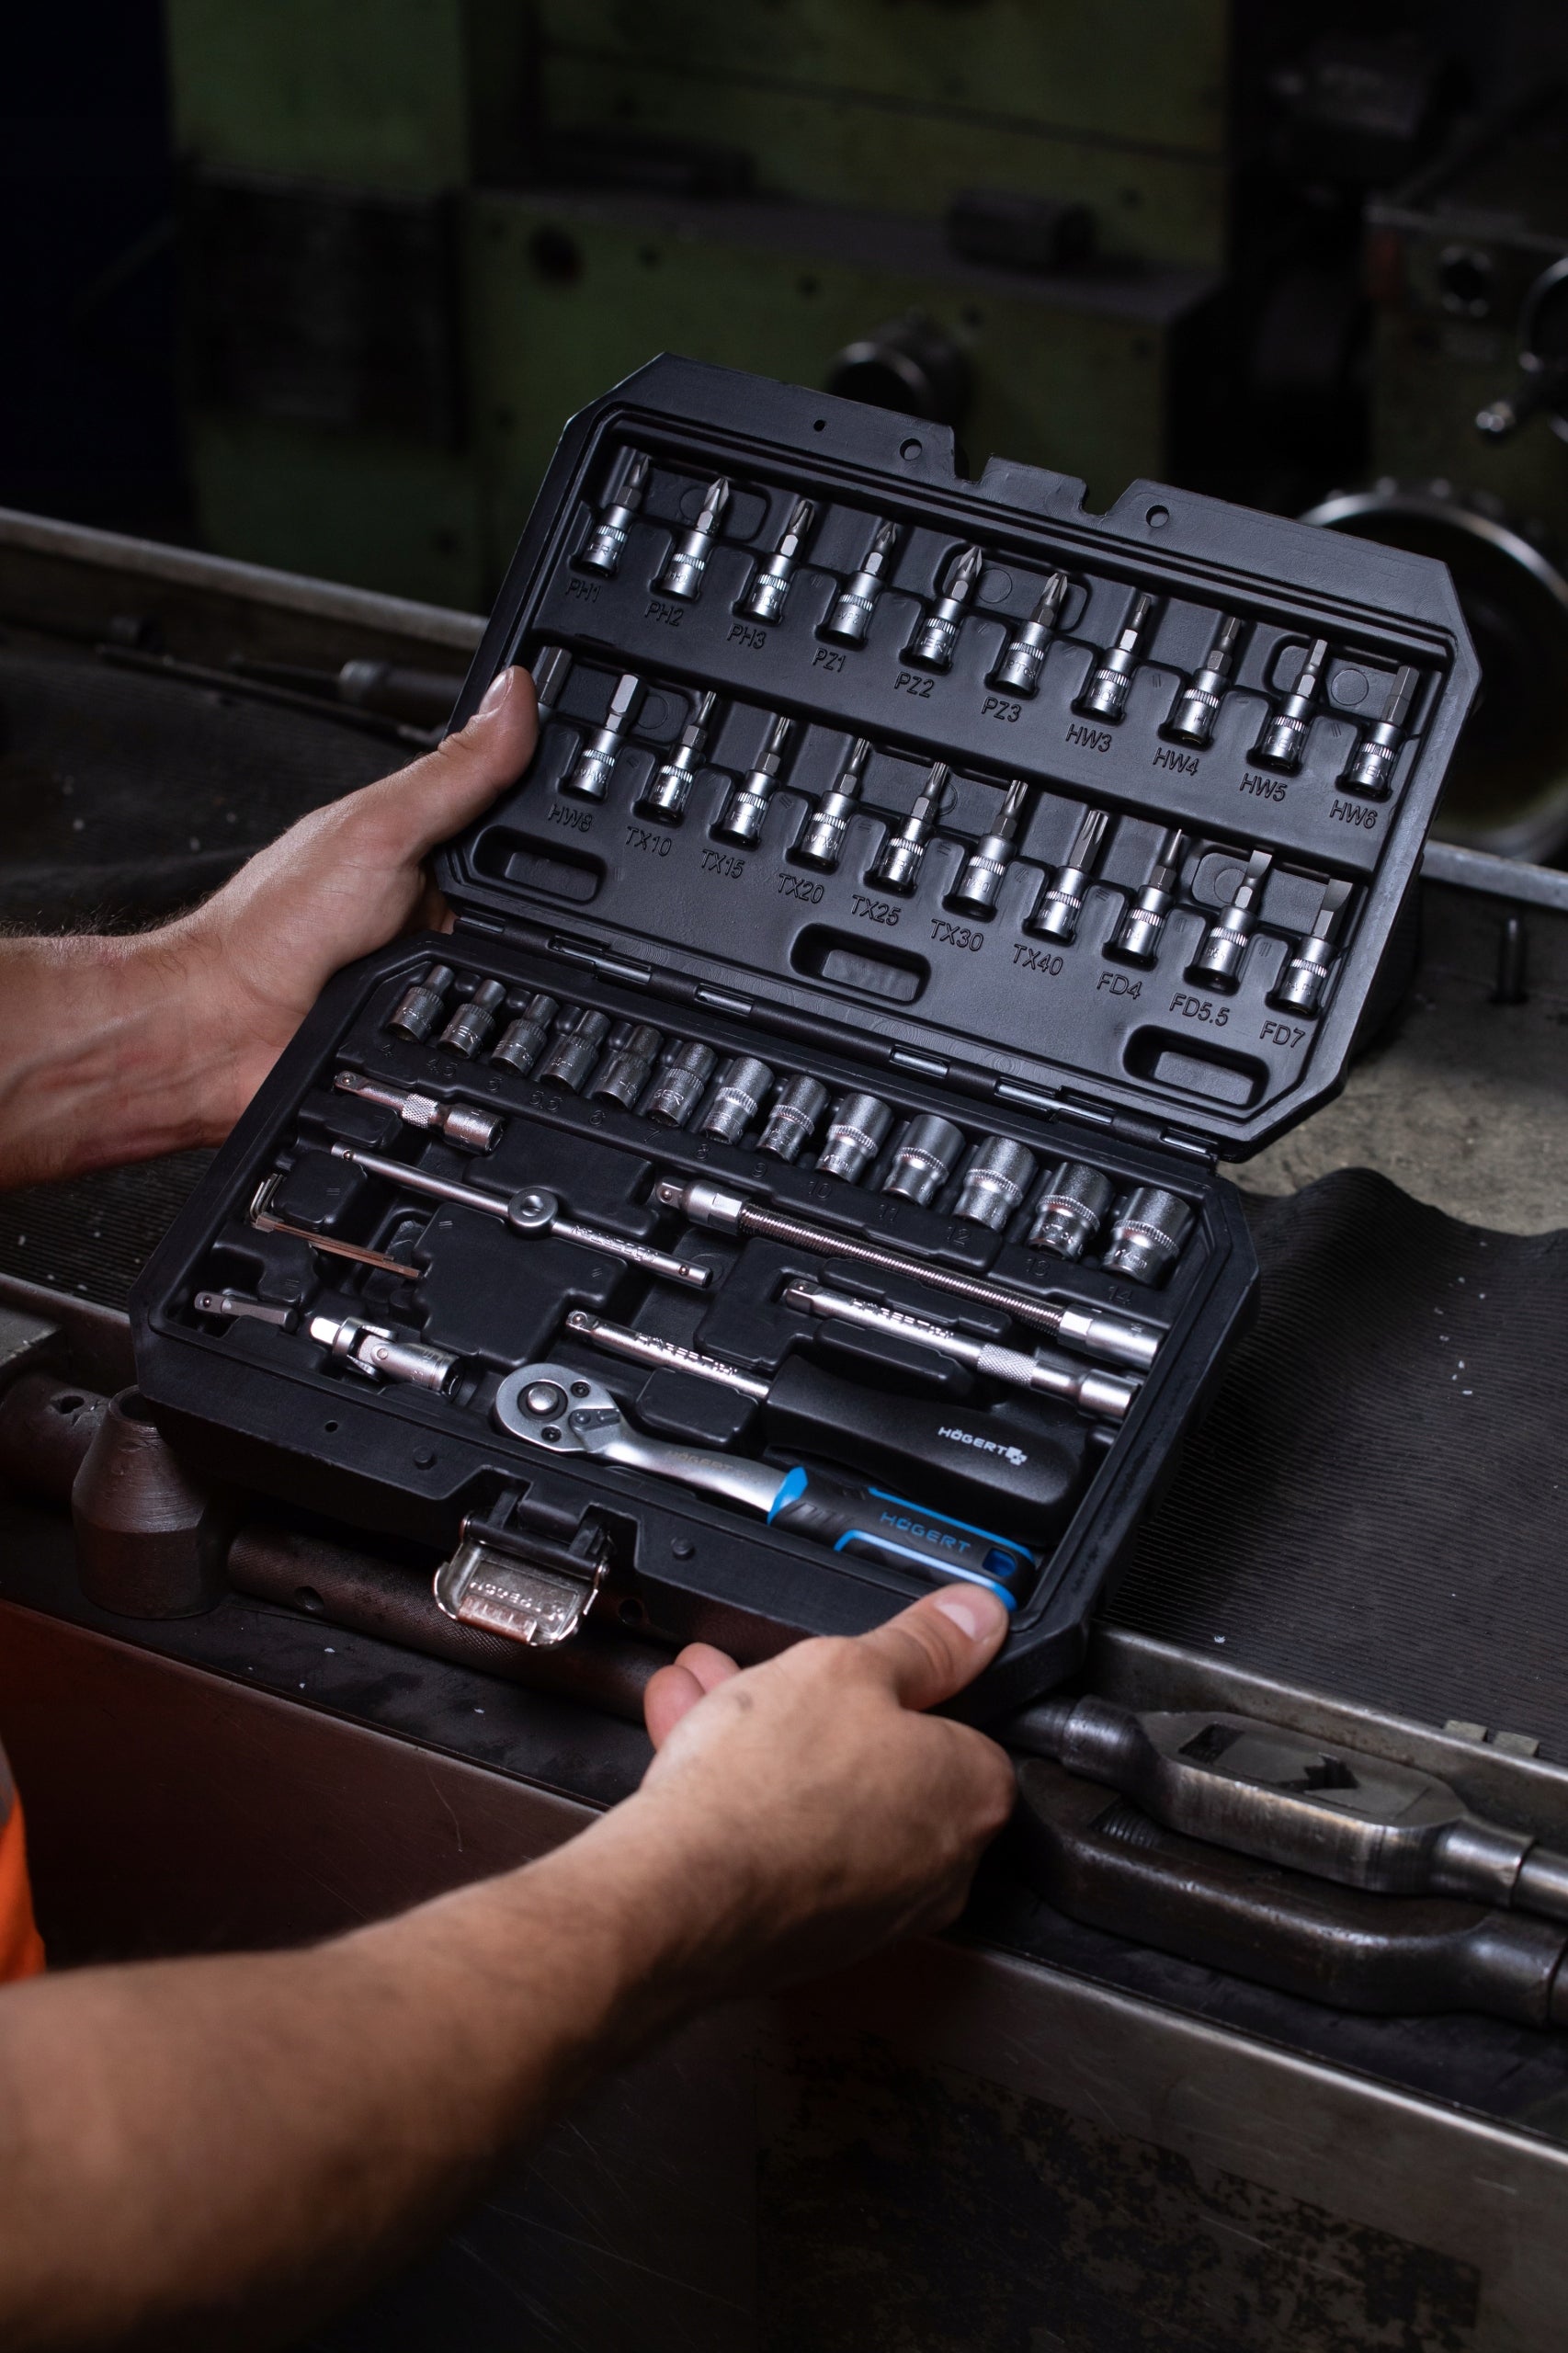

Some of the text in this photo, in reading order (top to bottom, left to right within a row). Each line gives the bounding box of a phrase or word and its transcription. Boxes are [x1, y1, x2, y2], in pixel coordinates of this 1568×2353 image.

[565, 580, 601, 602] PH1
[644, 601, 684, 627] PH2
[727, 624, 767, 649] PH3
[812, 648, 846, 673] PZ1
[894, 672, 935, 699] PZ2
[981, 697, 1021, 722] PZ3
[1065, 723, 1112, 752] HW3
[1153, 747, 1199, 776] HW4
[1240, 773, 1287, 802] HW5
[548, 803, 593, 833] HW8
[1329, 800, 1378, 829] HW6
[626, 826, 672, 857] TX10
[700, 848, 745, 879] TX15
[778, 873, 824, 904] TX20
[851, 894, 901, 926] TX25
[930, 918, 984, 951] TX30
[1012, 943, 1063, 976] TX40
[1096, 972, 1142, 1000] FD4
[1169, 993, 1230, 1027] FD5.5
[1259, 1020, 1306, 1048] FD7
[486, 1075, 503, 1092] 5
[643, 1127, 662, 1144] 7
[751, 1162, 767, 1180] 9
[808, 1180, 832, 1199] 10
[878, 1203, 900, 1222] 11
[946, 1224, 971, 1247] 12
[1024, 1257, 1051, 1278] 13
[1108, 1286, 1133, 1305] 14
[937, 1427, 1008, 1455] HÖGERT
[880, 1511, 971, 1553] HÖGERT
